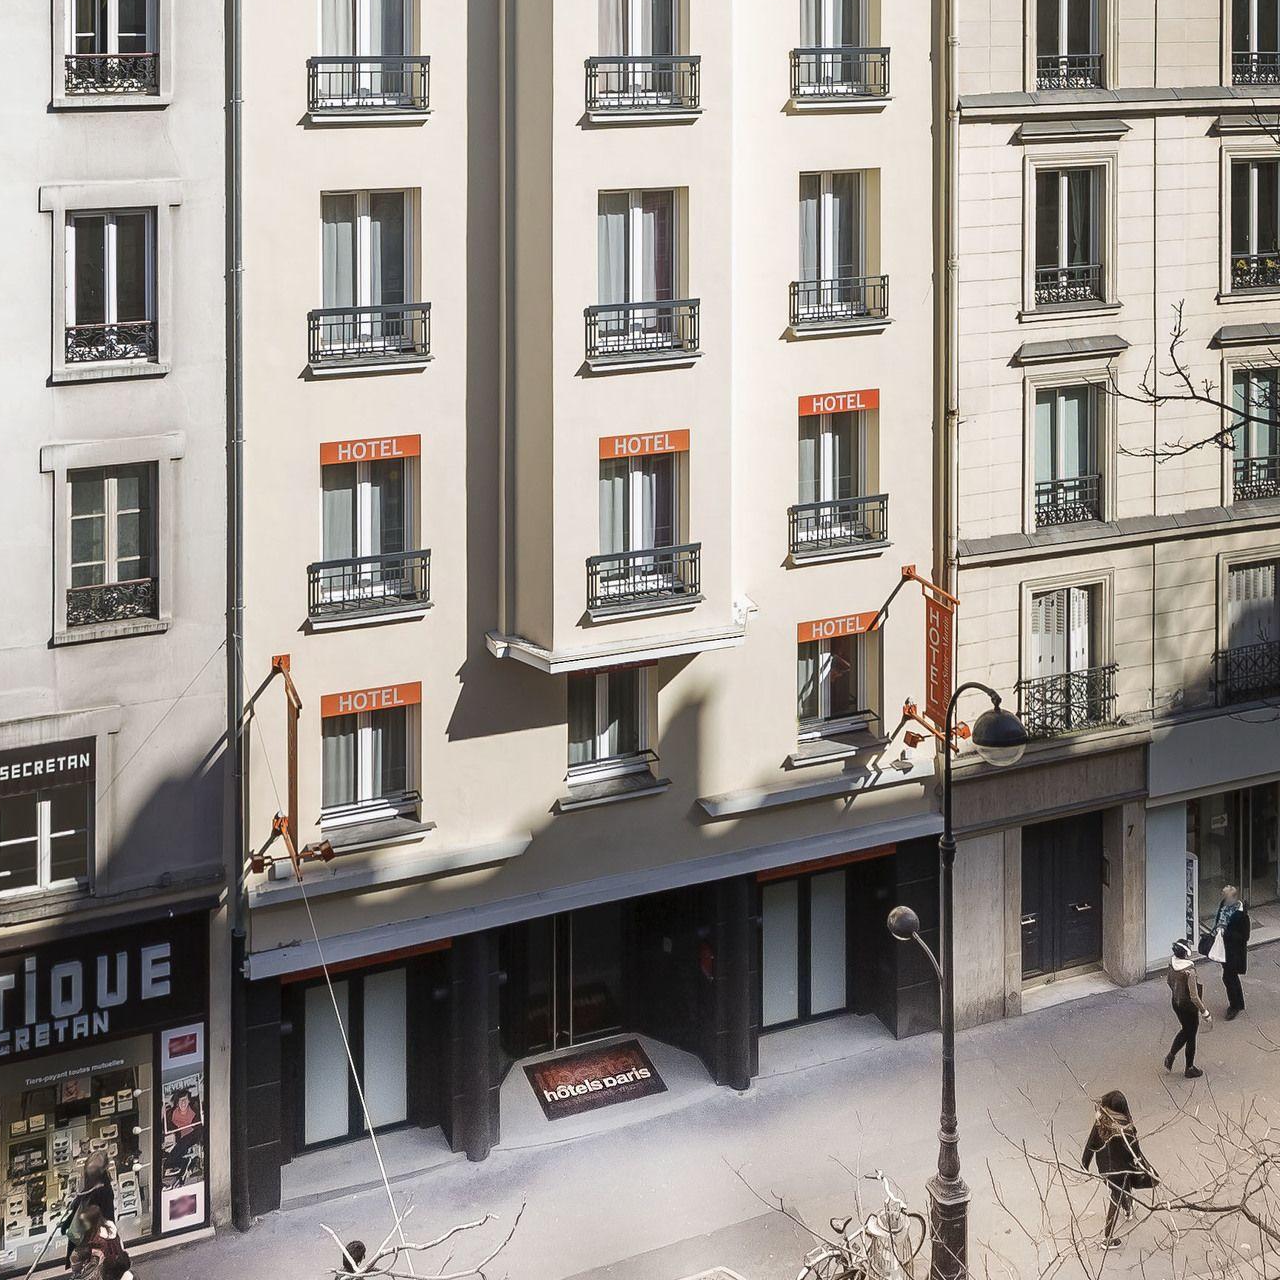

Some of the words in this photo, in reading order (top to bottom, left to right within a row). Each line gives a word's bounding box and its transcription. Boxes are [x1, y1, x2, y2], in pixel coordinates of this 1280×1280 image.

[812, 393, 866, 413] HOTEL
[338, 439, 403, 461] HOTEL
[613, 433, 676, 455] HOTEL
[811, 616, 865, 638] HOTEL
[929, 606, 941, 705] HOTEL
[339, 687, 404, 712] HOTEL
[0, 752, 90, 781] SECRETAN
[1128, 824, 1135, 838] 7
[543, 1079, 604, 1102] hôtels
